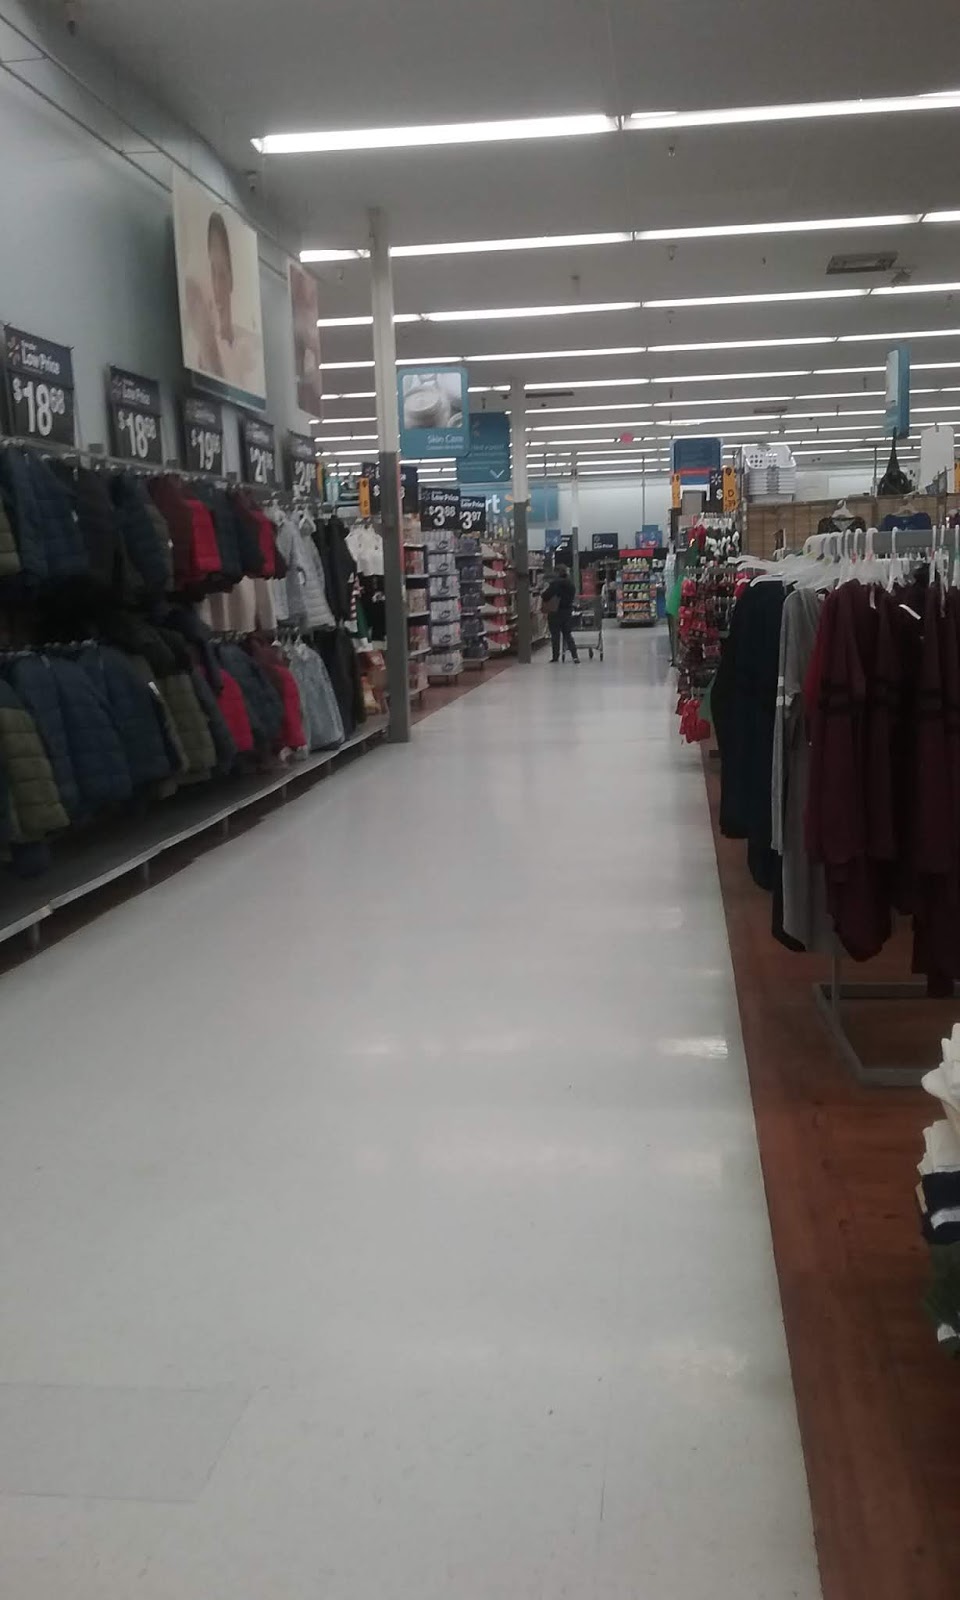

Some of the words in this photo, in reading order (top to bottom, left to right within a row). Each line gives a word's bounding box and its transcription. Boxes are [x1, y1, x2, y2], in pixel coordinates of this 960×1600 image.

[427, 433, 444, 445] Skin
[445, 433, 464, 444] Care
[431, 492, 444, 501] Low
[444, 493, 460, 501] Price
